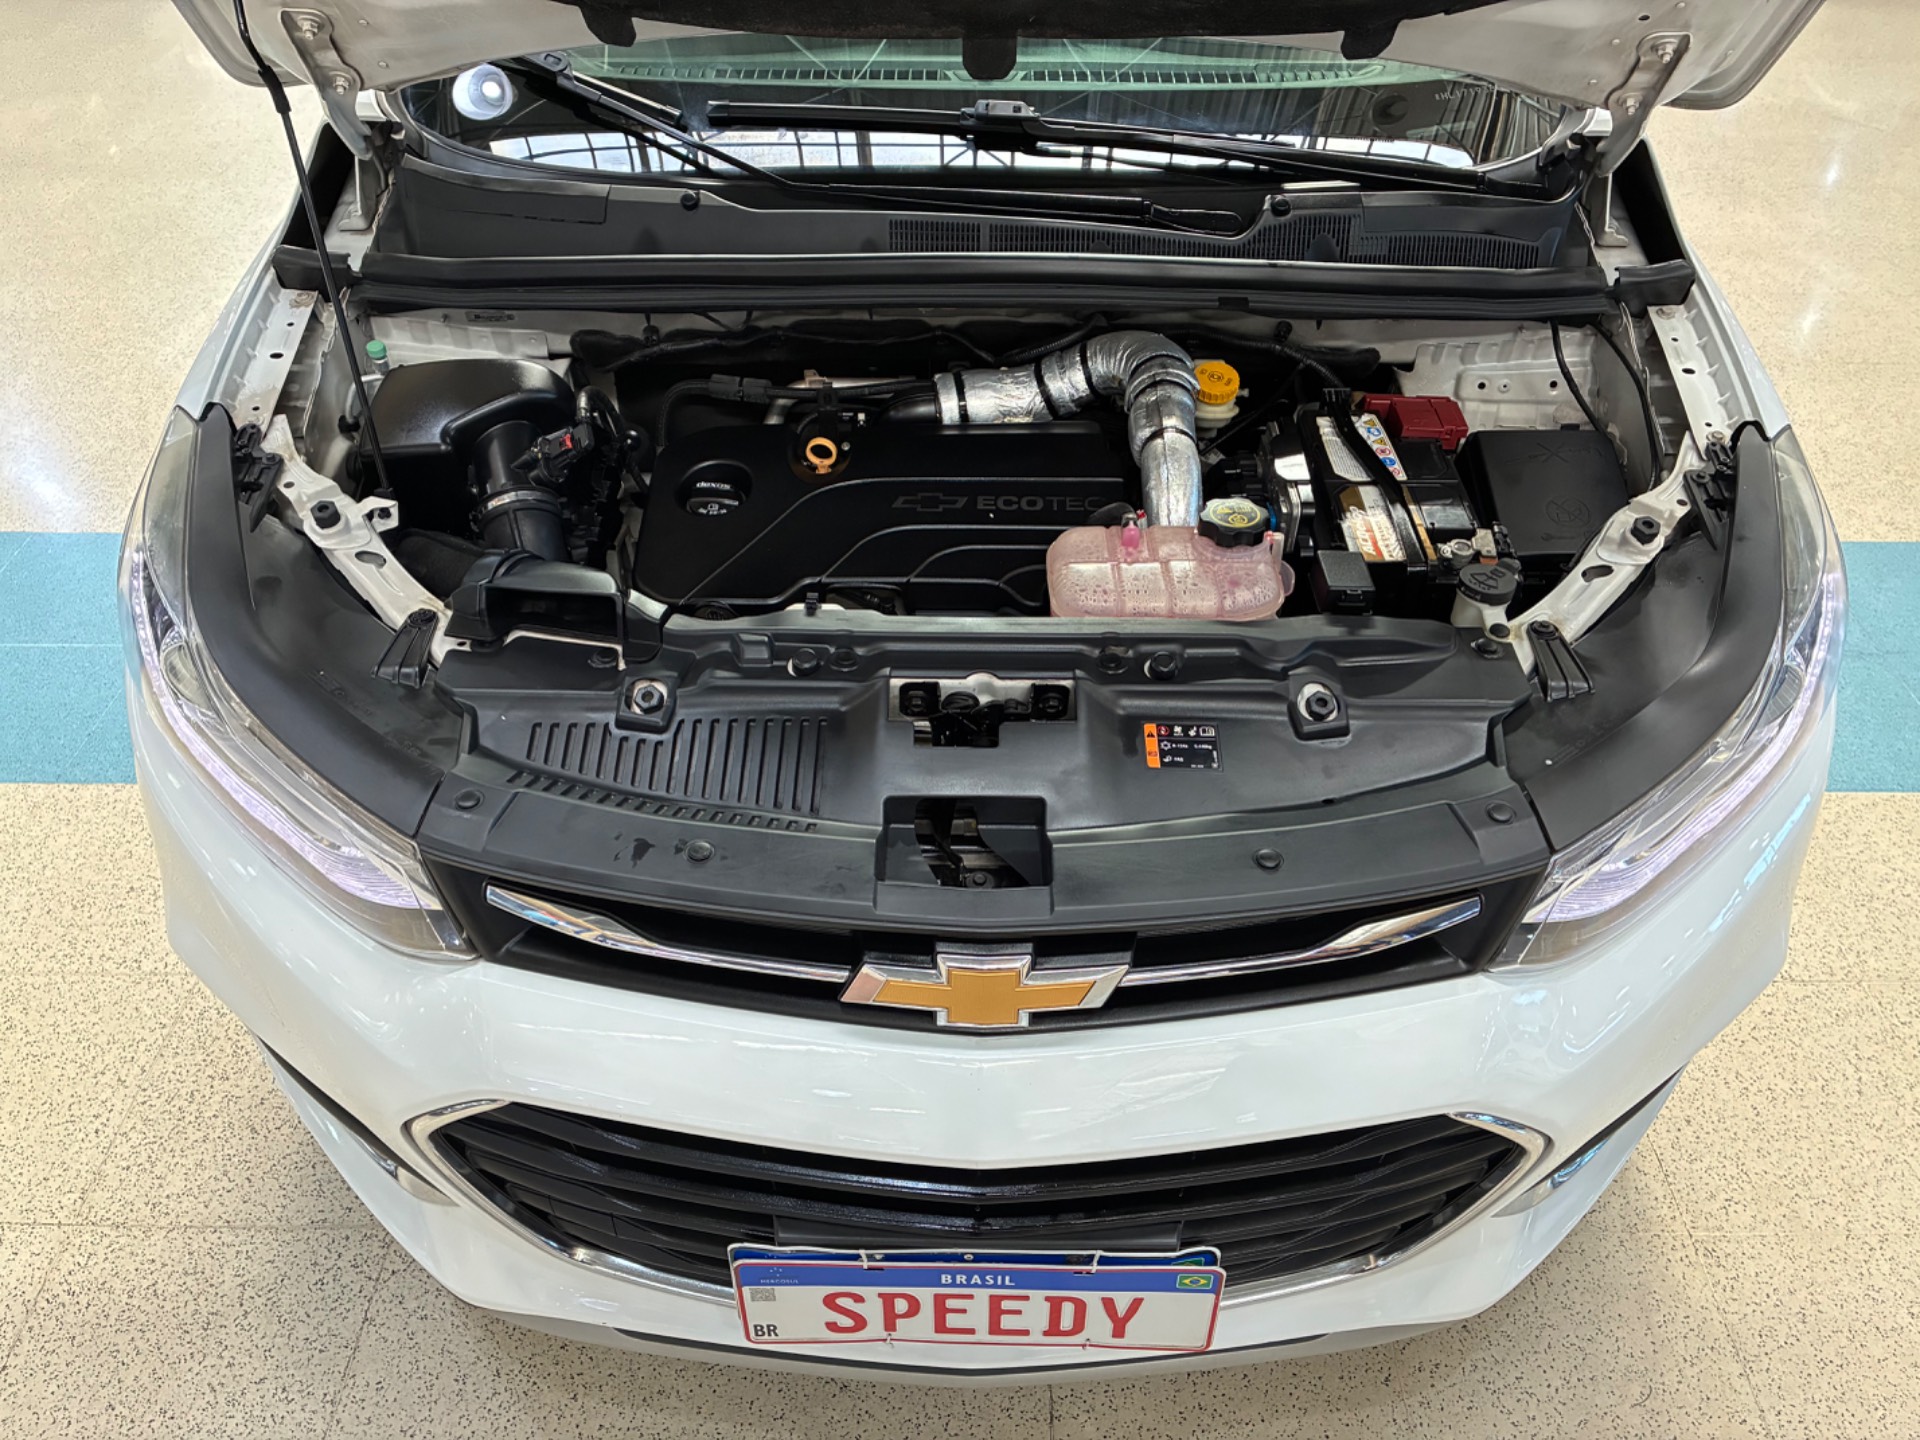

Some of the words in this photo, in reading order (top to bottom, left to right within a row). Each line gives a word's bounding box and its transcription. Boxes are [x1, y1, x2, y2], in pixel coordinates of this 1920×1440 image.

[941, 1273, 1016, 1287] BRASIL
[822, 1291, 1145, 1339] SPEEDY
[753, 1323, 779, 1338] BR
